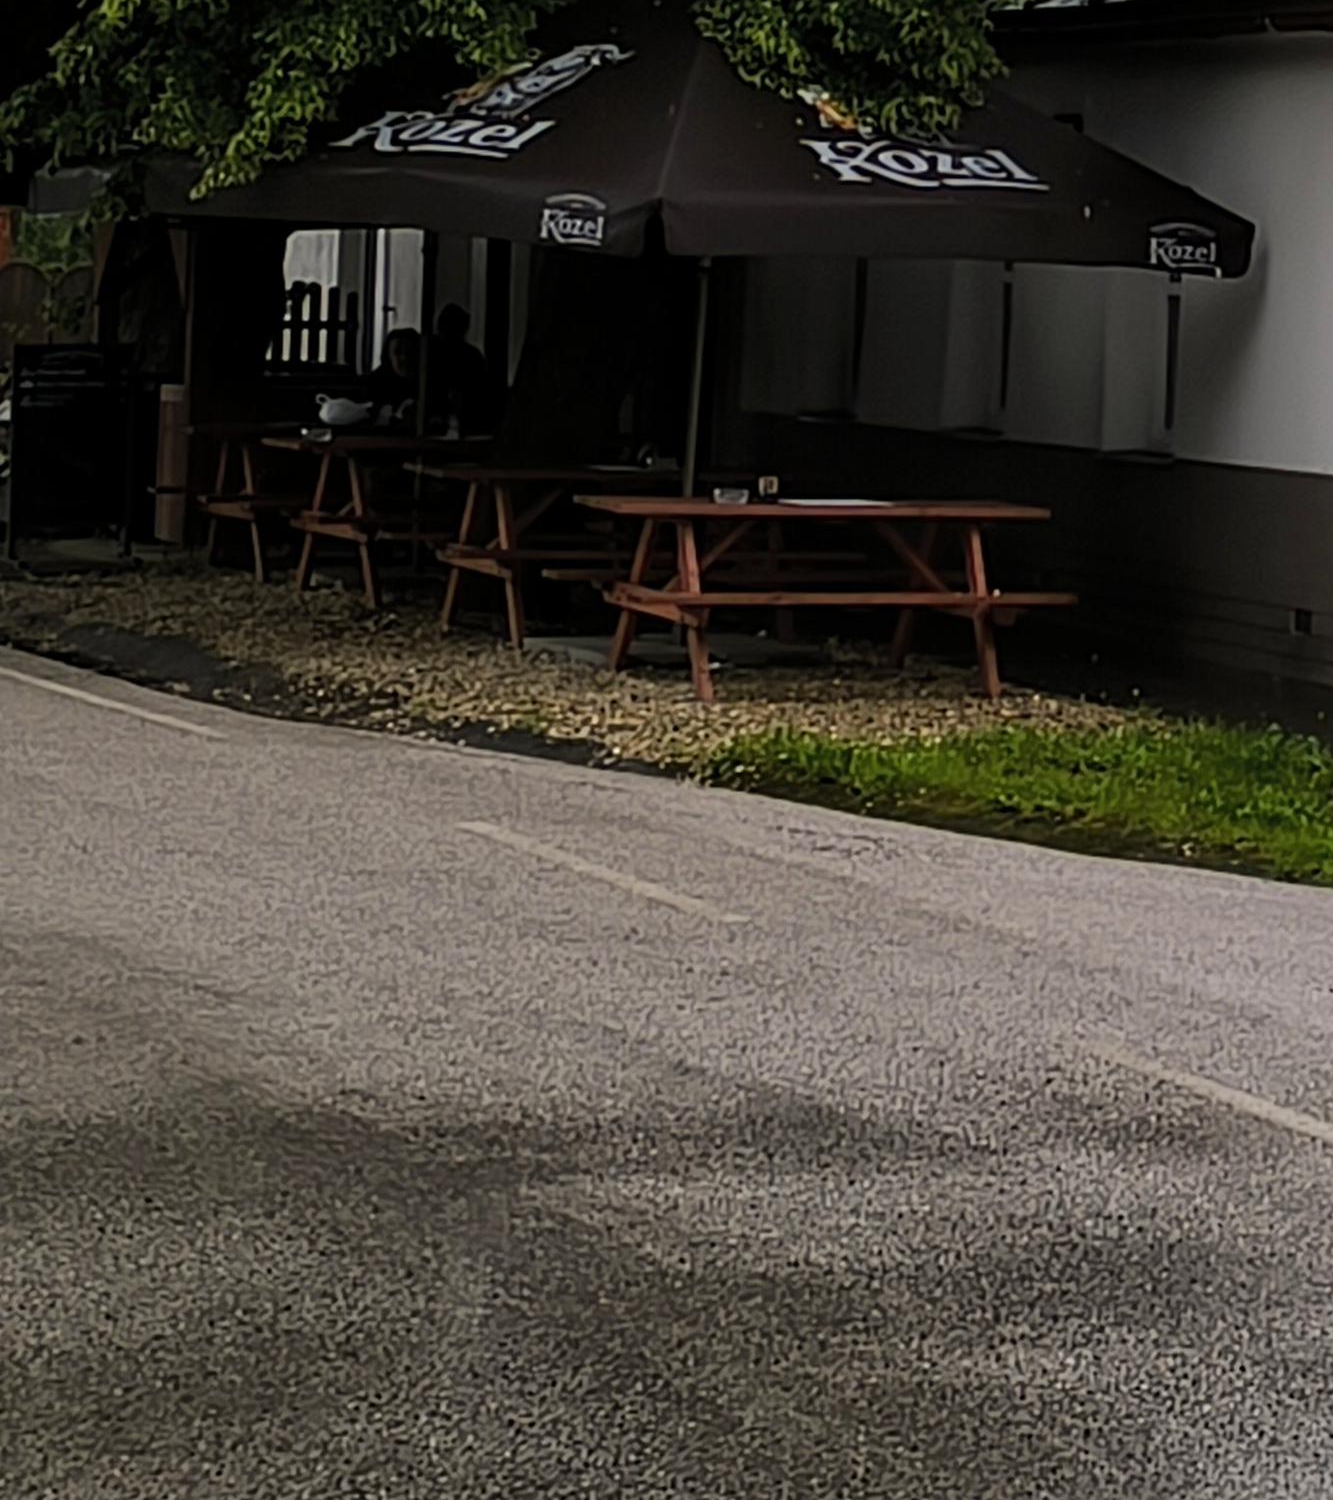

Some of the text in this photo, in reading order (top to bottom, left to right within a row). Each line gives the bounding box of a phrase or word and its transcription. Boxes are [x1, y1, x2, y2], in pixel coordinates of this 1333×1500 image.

[328, 110, 557, 156] Kozel
[799, 137, 1047, 189] Kozel
[540, 207, 605, 245] Kozel
[1149, 236, 1218, 274] Kozel
